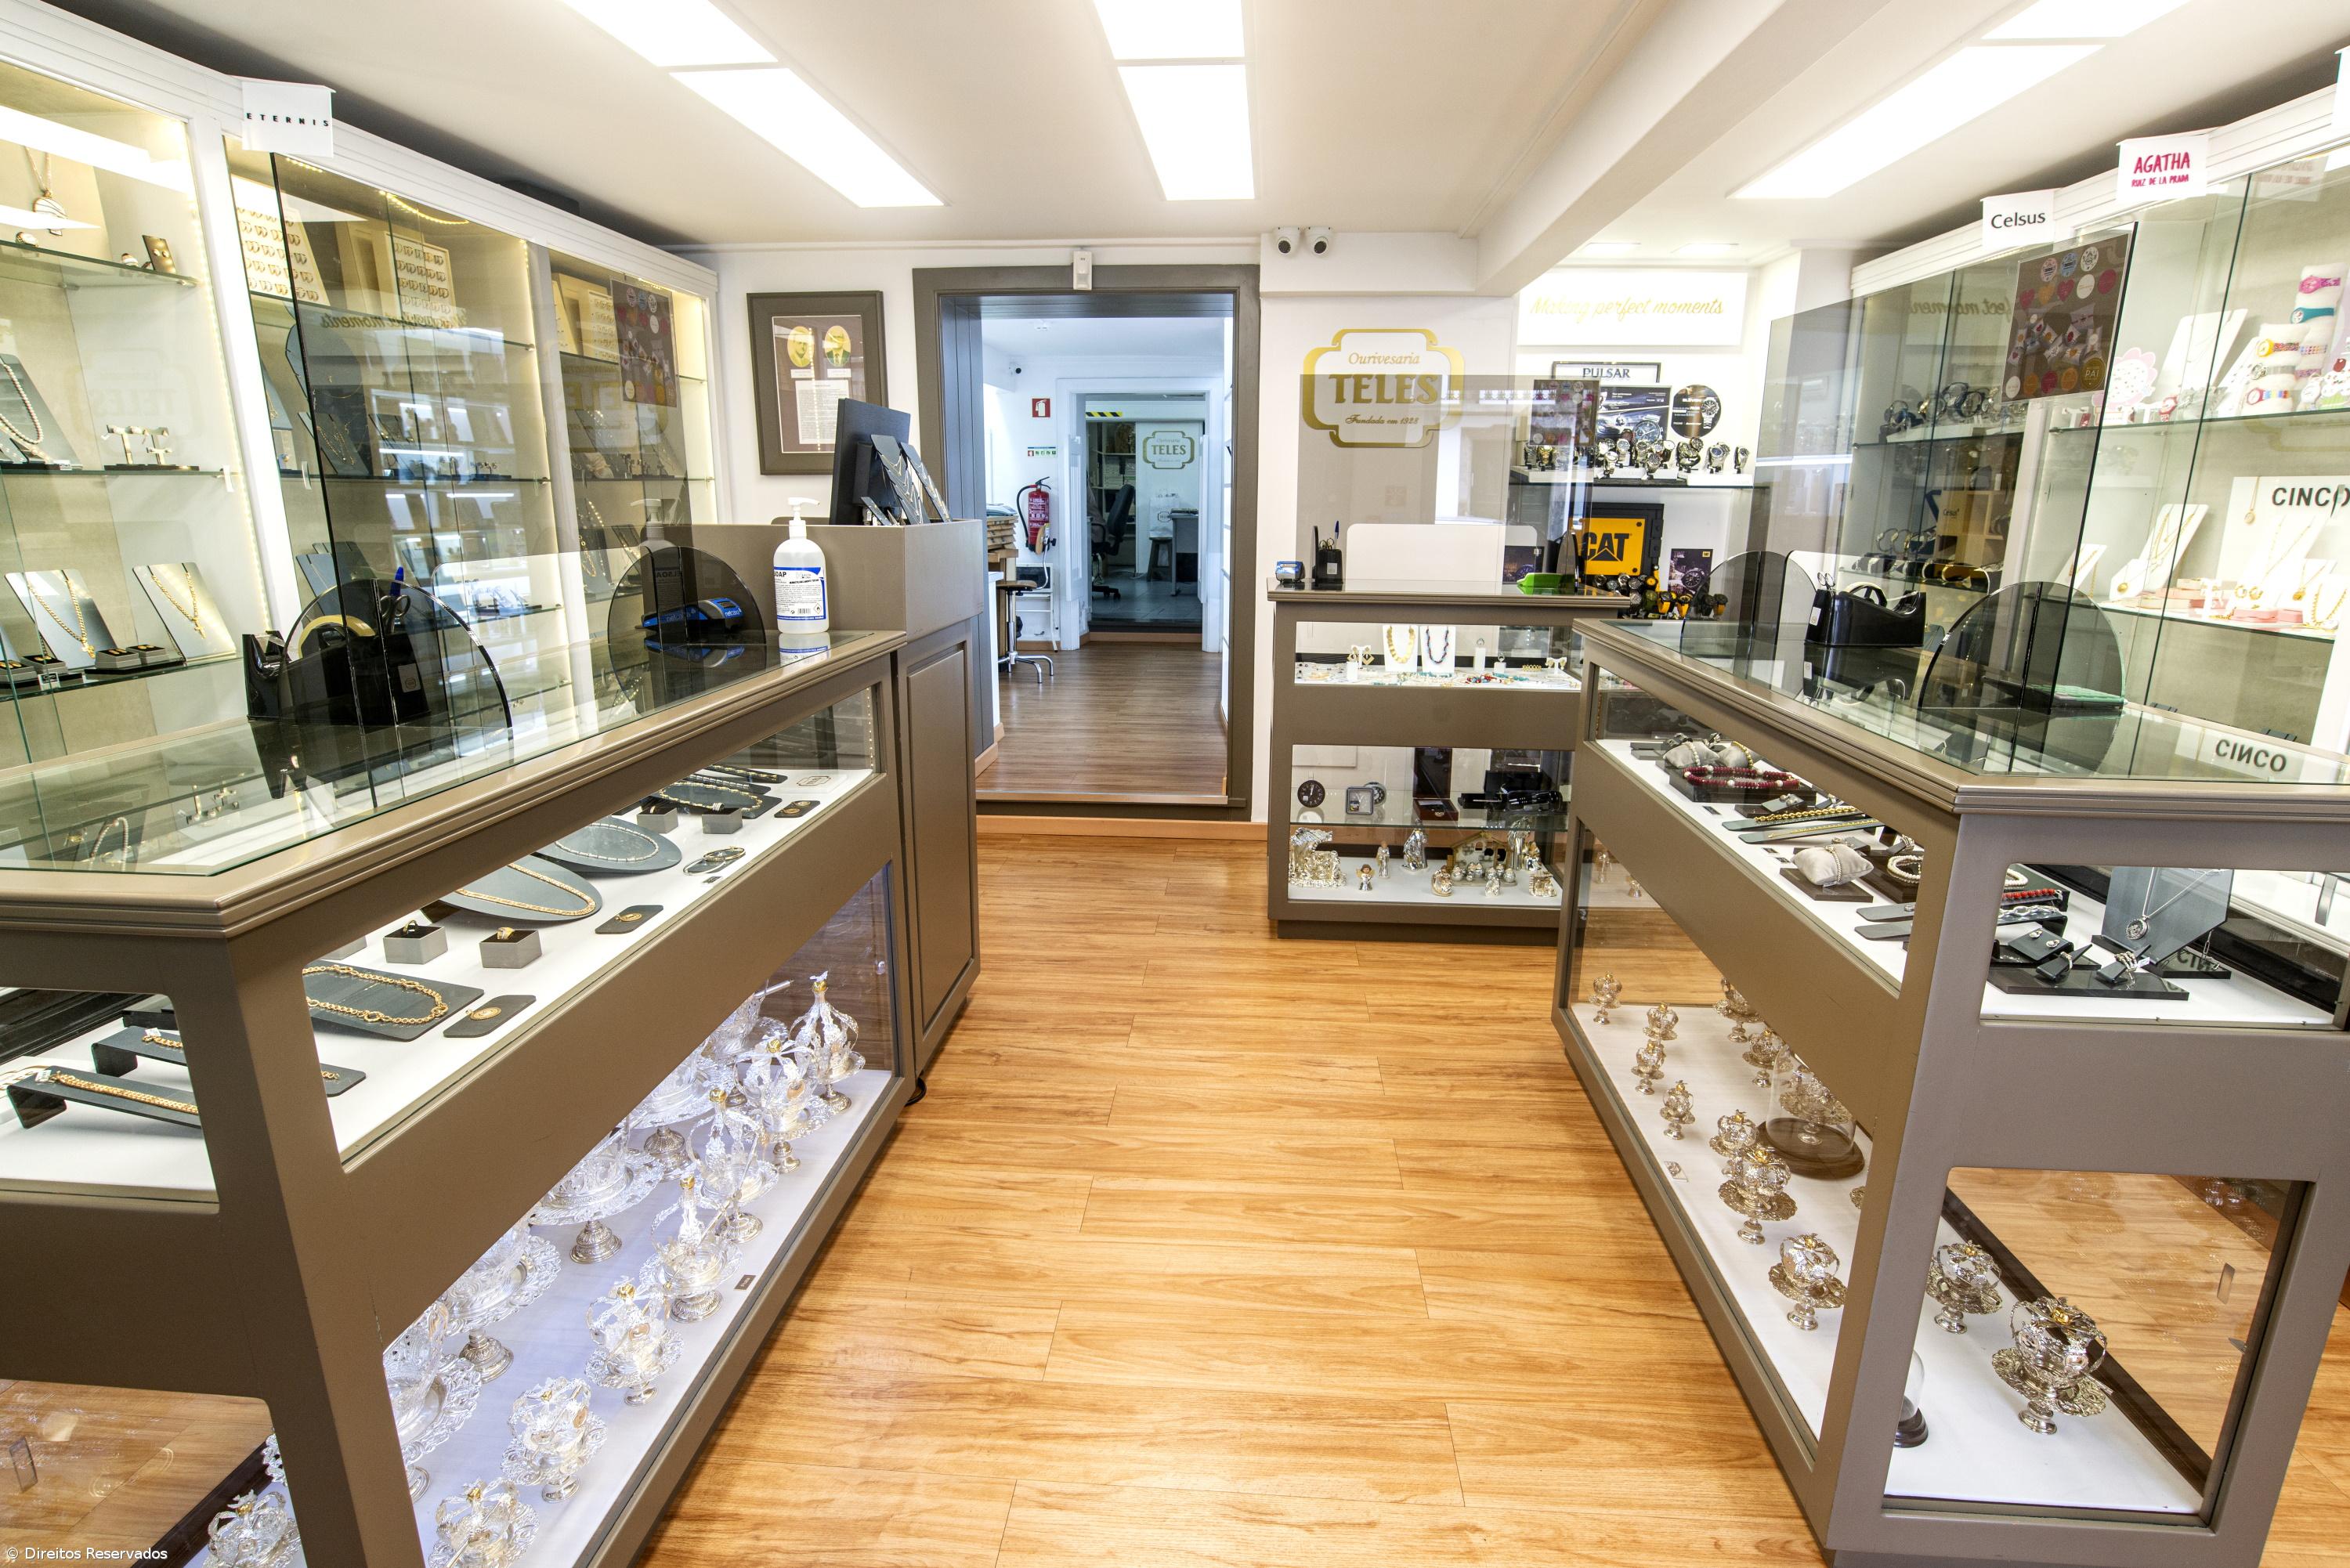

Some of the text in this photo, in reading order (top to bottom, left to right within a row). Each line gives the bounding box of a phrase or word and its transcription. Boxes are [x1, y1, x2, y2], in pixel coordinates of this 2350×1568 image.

[246, 113, 329, 127] ETERNIS
[2133, 151, 2190, 174] AGATHA
[2131, 178, 2146, 187] RUIZ
[2149, 176, 2157, 186] DE
[2159, 175, 2167, 185] LA
[1990, 211, 2046, 229] Celsus
[1591, 297, 1651, 322] perfect
[1653, 298, 1724, 314] moments
[1348, 352, 1420, 365] Ourivesaria
[1582, 367, 1631, 379] PULSAR
[1328, 374, 1440, 404] TELES
[1345, 414, 1385, 425] Fundada
[1151, 444, 1187, 455] TELES
[1581, 532, 1630, 562] CAT
